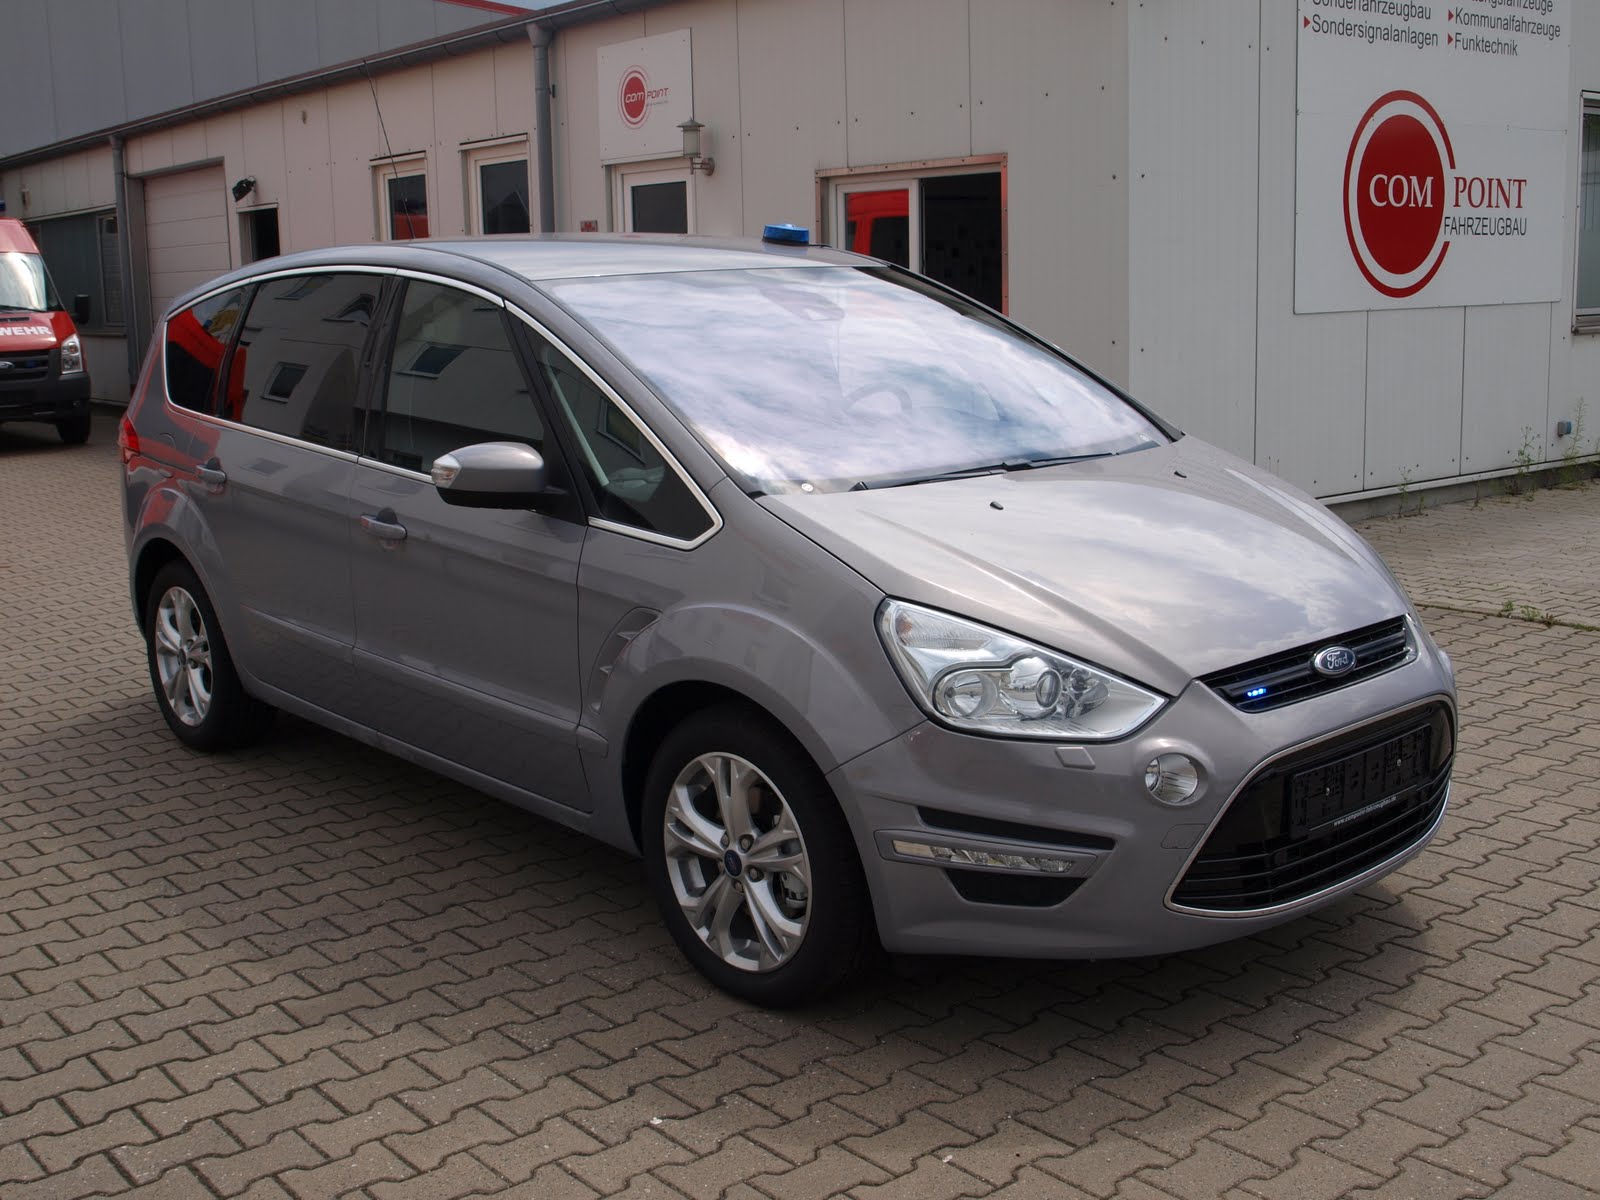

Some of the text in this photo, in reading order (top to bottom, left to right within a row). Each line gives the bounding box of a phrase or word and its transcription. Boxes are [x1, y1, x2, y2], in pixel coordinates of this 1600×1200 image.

[1313, 0, 1431, 21] nderfahrzeugbau
[1311, 14, 1438, 49] Sondersignalanlagen
[1455, 7, 1561, 40] Kommunalfahrzeuge
[1454, 32, 1518, 56] Funktechnik
[1369, 173, 1527, 209] COM POINT
[1444, 216, 1527, 236] FAHRZEUGBAU
[1327, 651, 1348, 669] Ford
